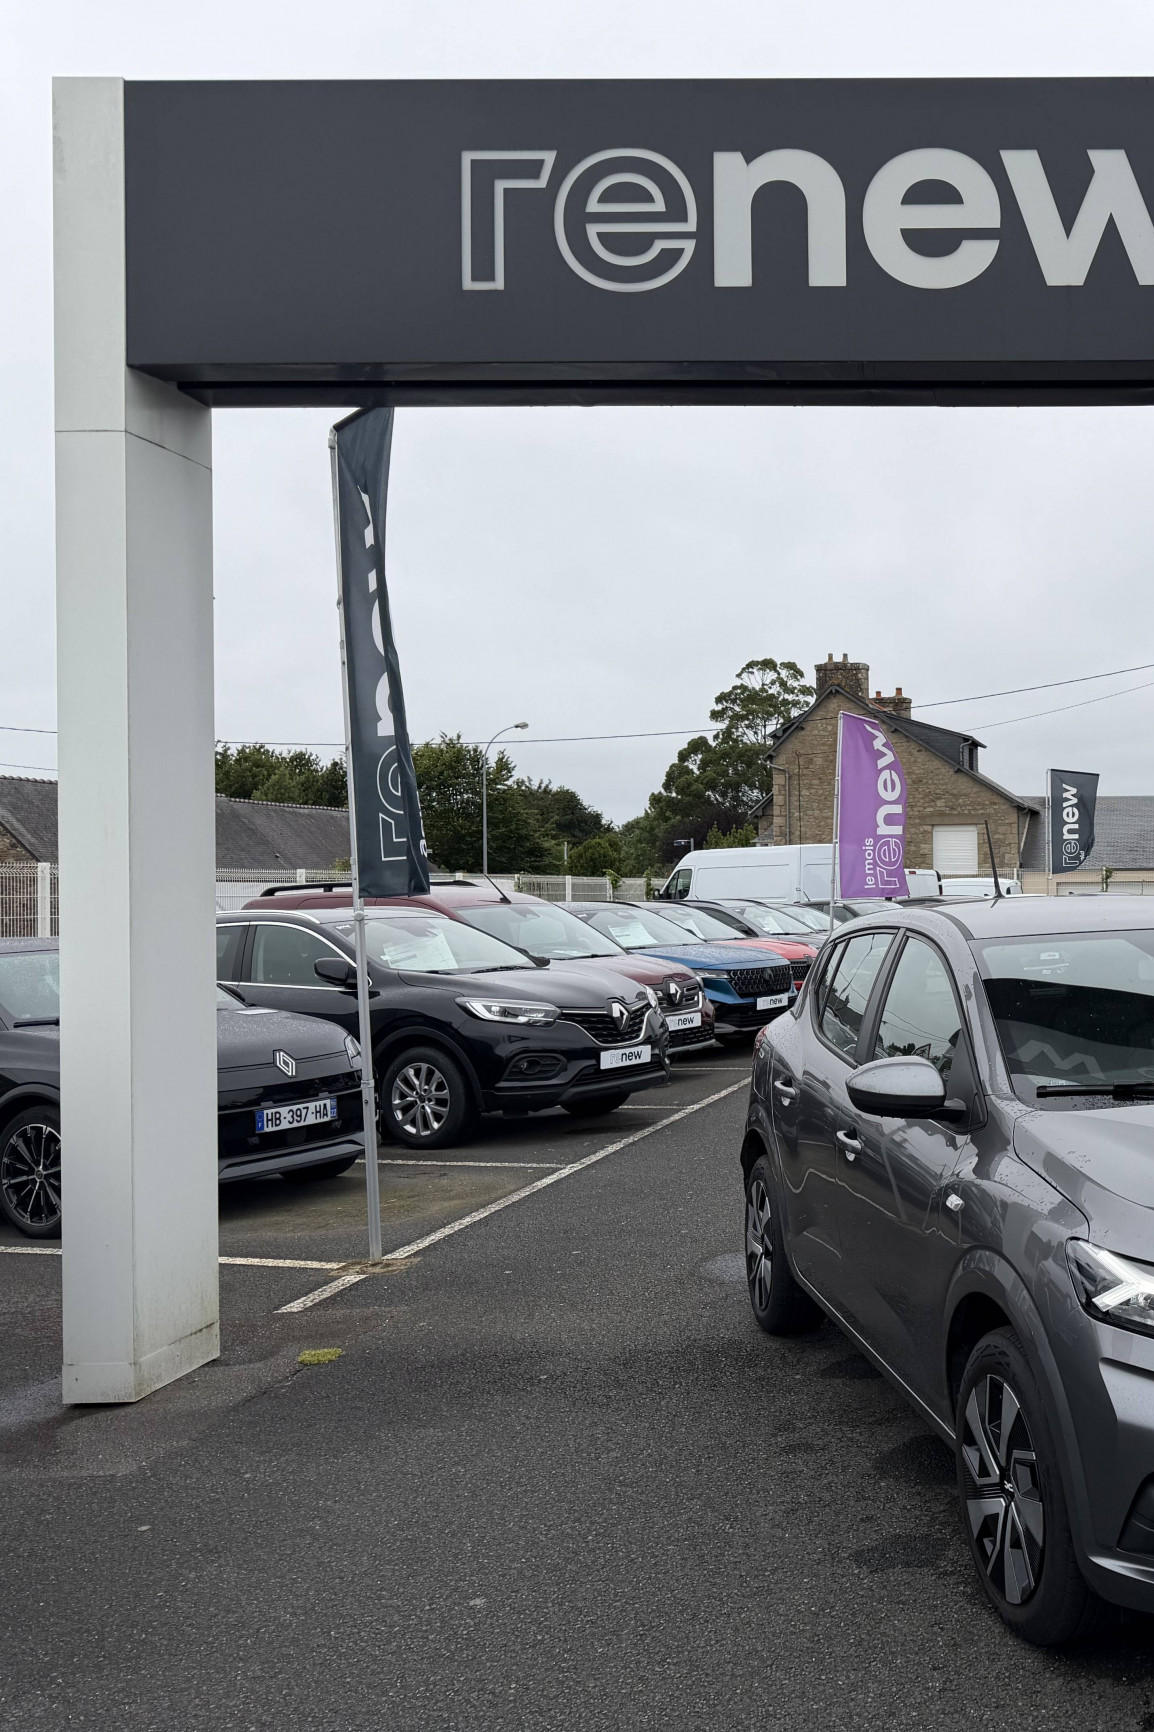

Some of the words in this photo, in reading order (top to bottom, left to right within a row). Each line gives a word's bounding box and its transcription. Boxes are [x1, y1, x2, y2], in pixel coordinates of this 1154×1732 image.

[864, 723, 904, 888] renew
[1062, 783, 1080, 867] renew
[862, 837, 874, 874] mois
[864, 876, 876, 889] le
[609, 1050, 643, 1065] renew
[266, 1103, 329, 1128] HB-397-HA
